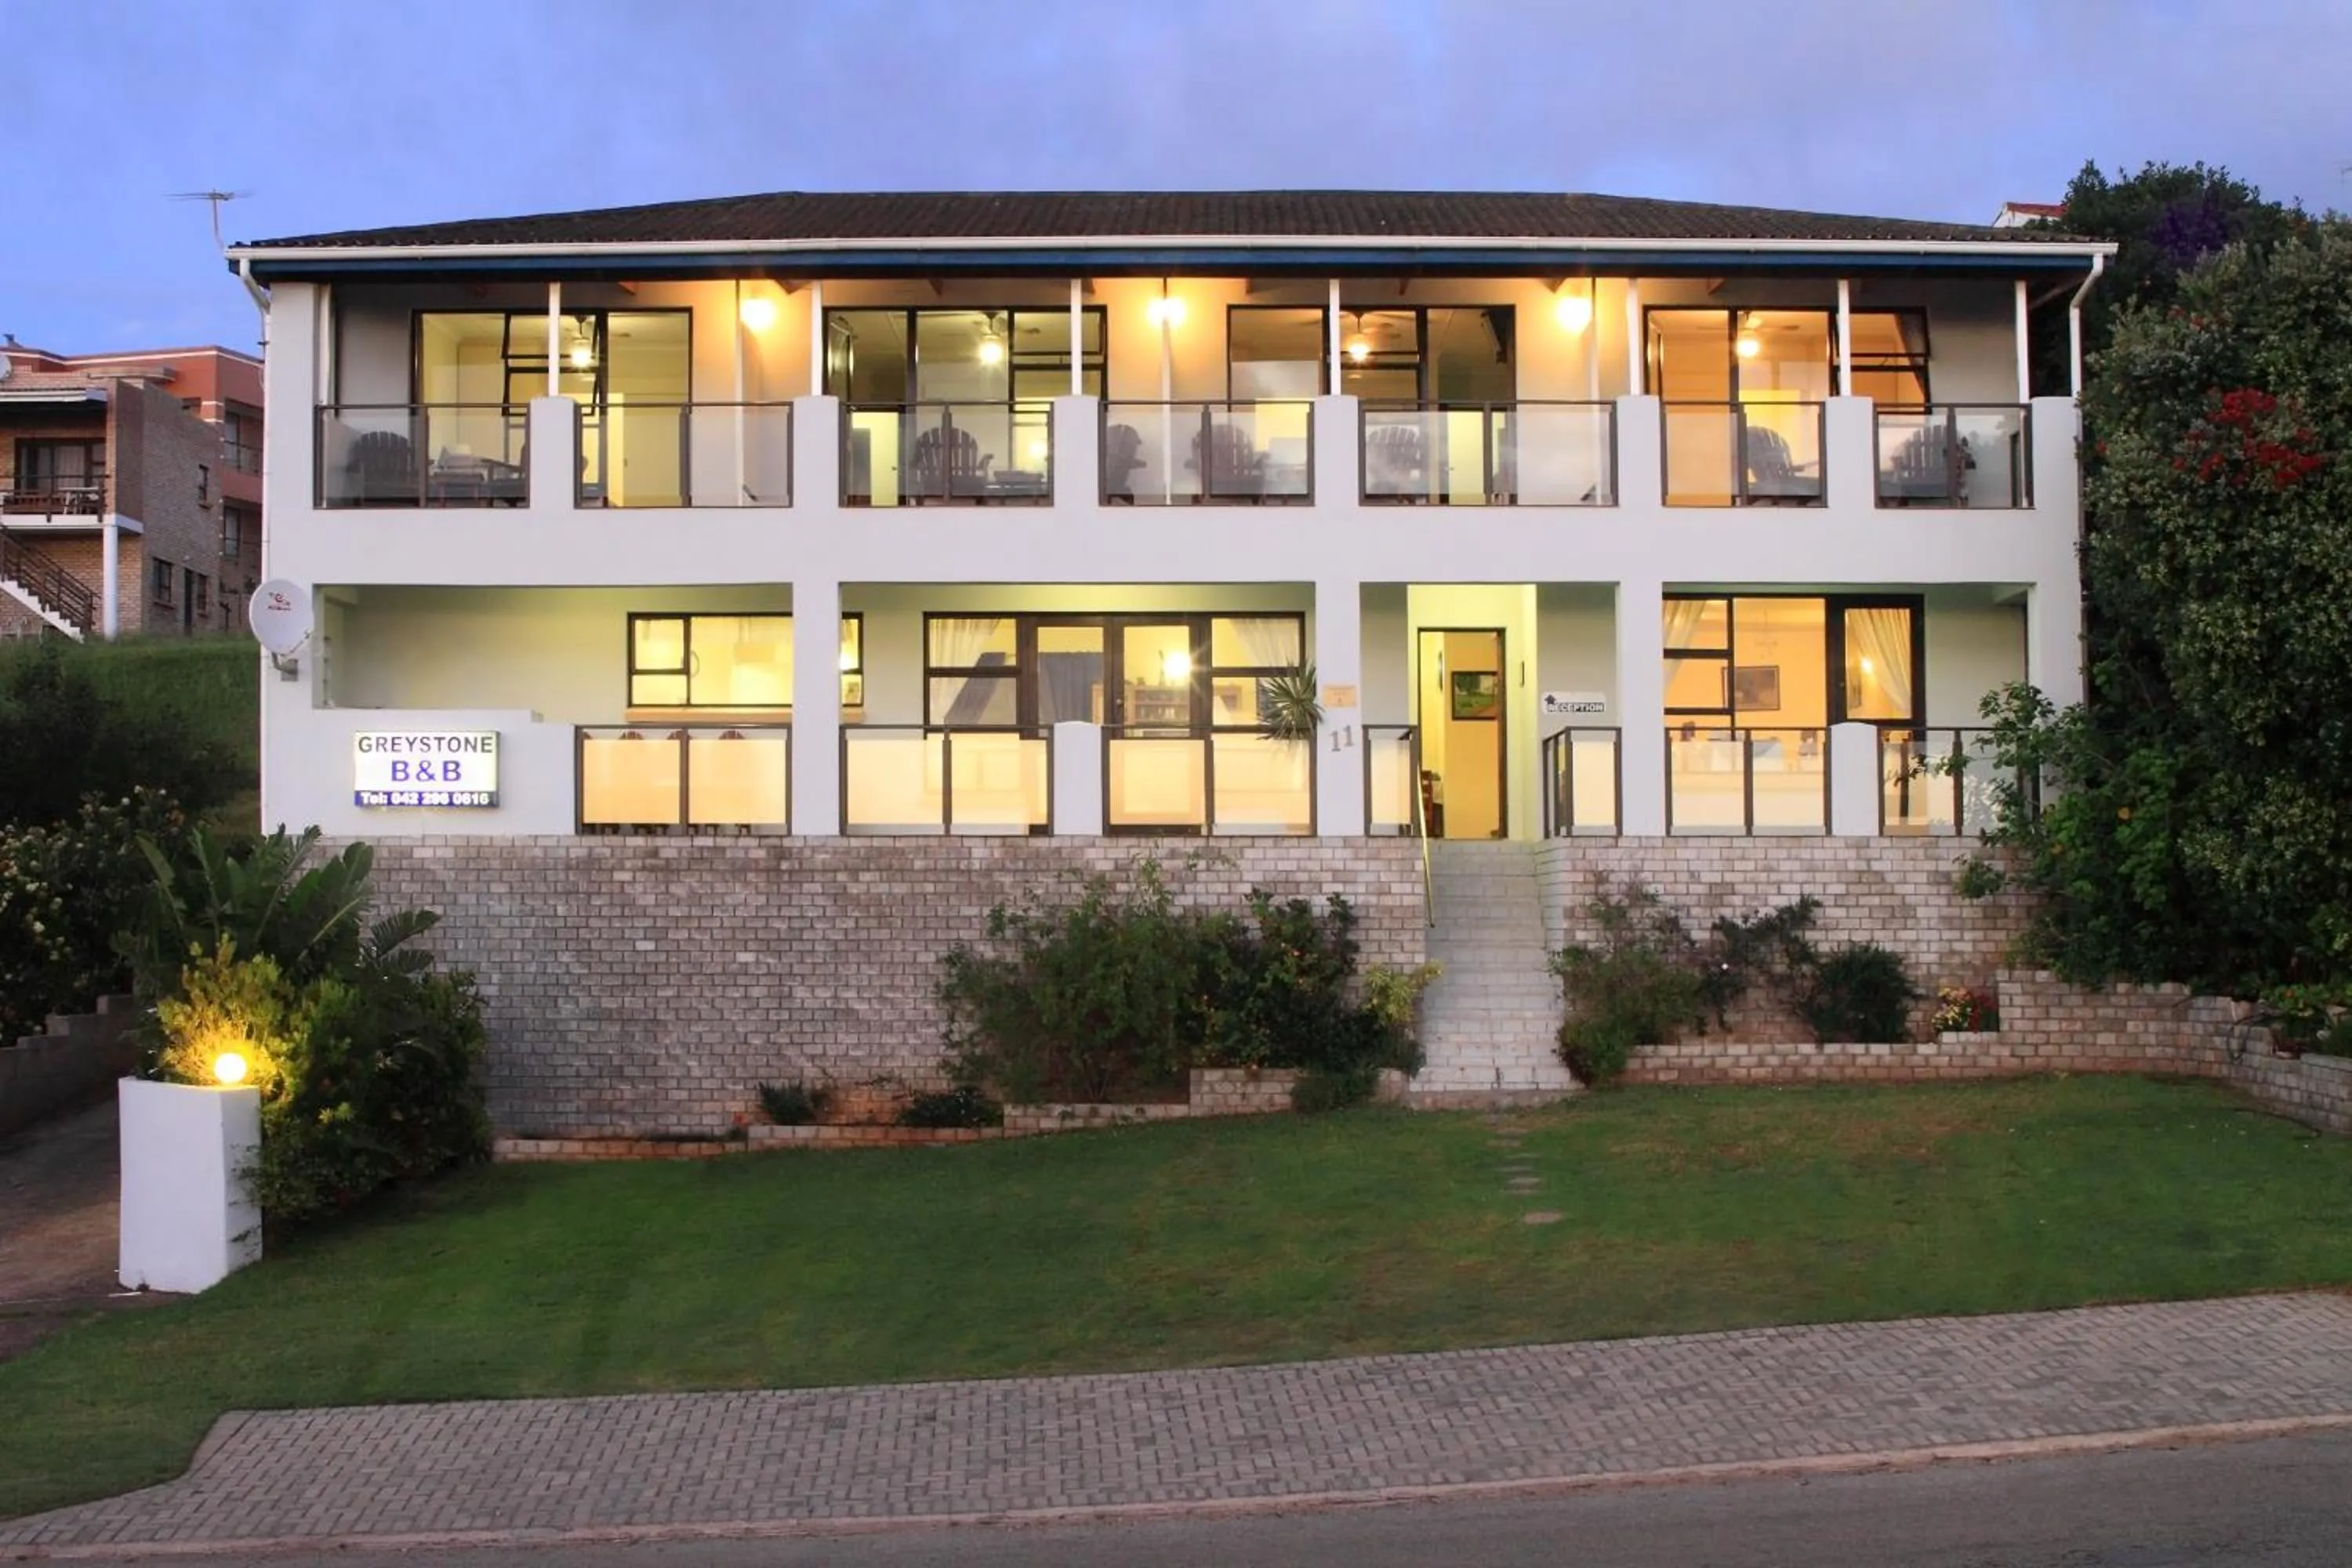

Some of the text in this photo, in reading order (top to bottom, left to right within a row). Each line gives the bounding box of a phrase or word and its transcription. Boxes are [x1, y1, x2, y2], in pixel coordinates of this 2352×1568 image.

[358, 736, 493, 753] GREYSTONE
[1330, 724, 1354, 751] 11
[361, 793, 387, 805] Tel:
